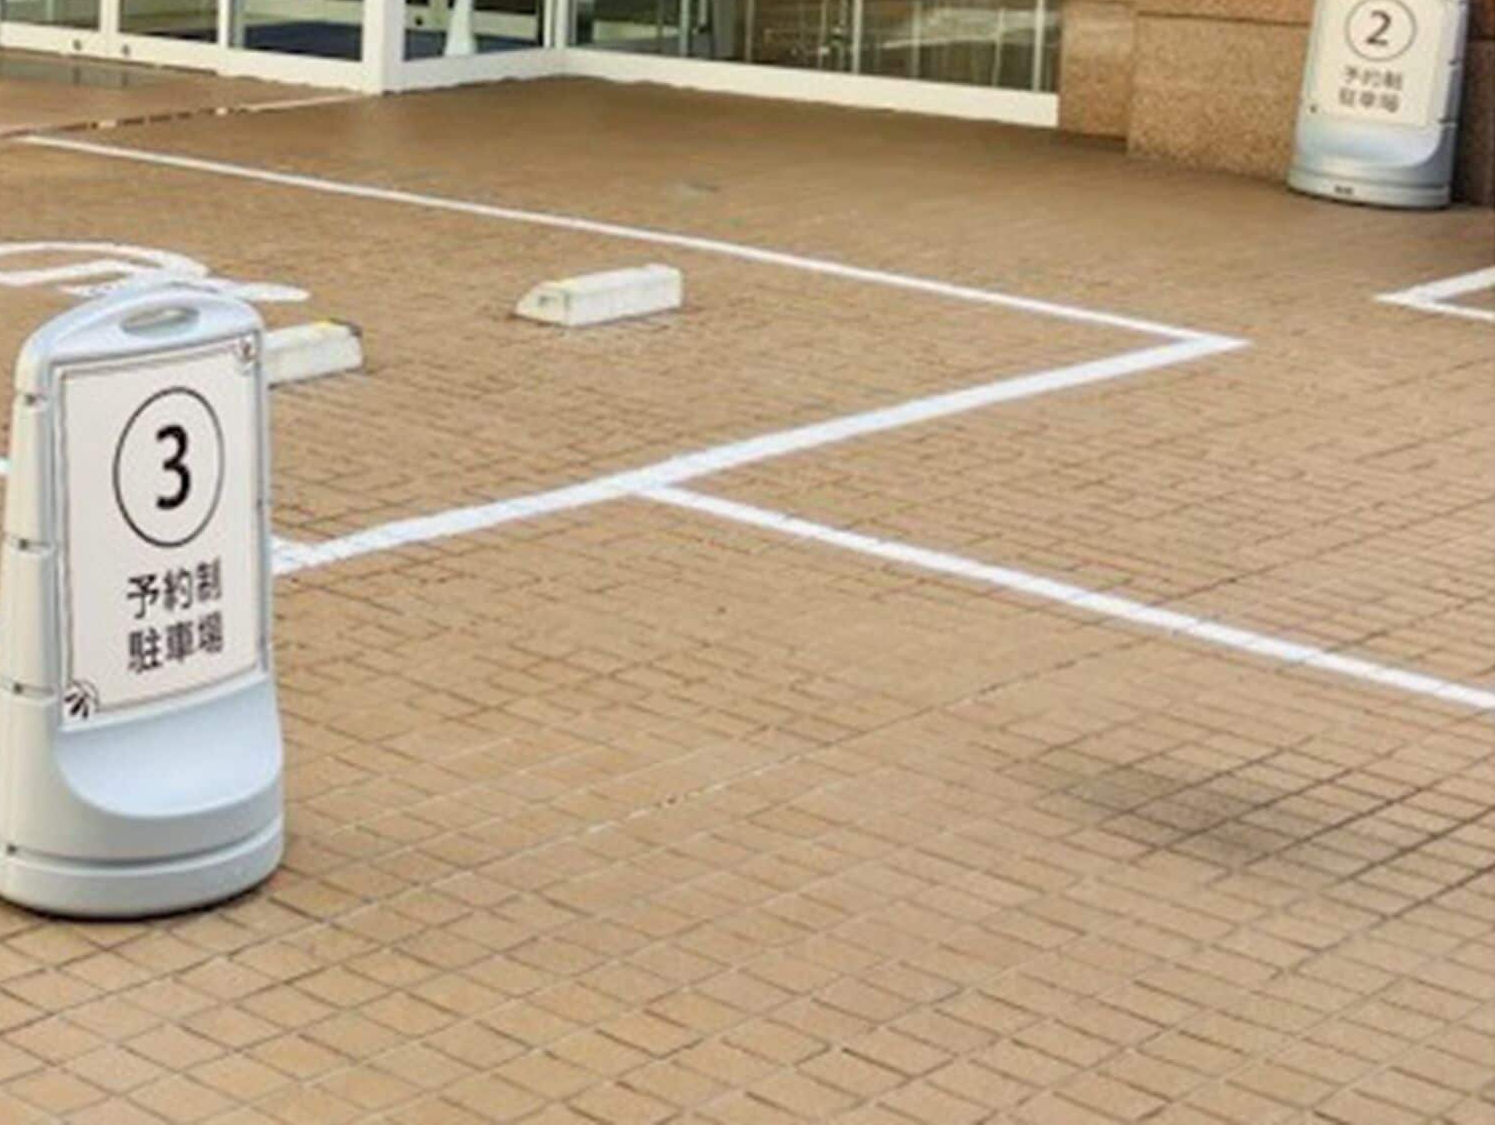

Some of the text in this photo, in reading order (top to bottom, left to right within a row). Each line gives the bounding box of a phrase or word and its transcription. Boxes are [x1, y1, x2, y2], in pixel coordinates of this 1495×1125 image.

[1364, 10, 1393, 47] 2
[155, 424, 191, 511] 3
[127, 556, 222, 619] 予約制
[127, 611, 224, 674] 駐車場
